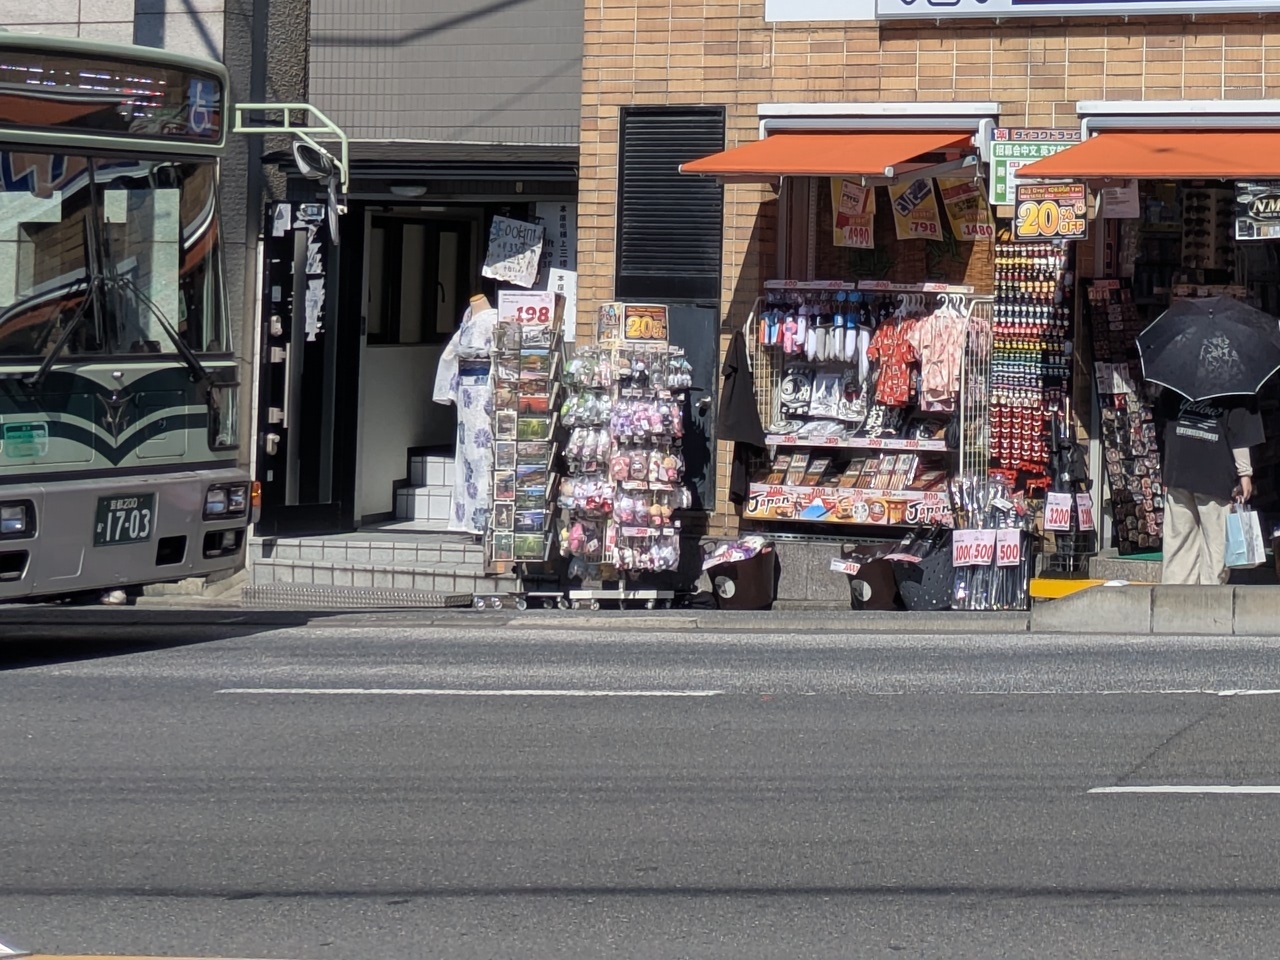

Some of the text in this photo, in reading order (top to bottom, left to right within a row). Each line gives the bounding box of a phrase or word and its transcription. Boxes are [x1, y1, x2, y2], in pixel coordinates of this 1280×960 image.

[911, 221, 937, 234] 798
[965, 224, 993, 236] 1480
[1058, 219, 1086, 235] OFF
[515, 306, 550, 324] 198
[747, 493, 790, 514] Japan
[906, 501, 951, 523] Japan
[106, 509, 151, 541] 17-03
[1050, 508, 1069, 525] 3200
[974, 543, 993, 561] 500
[1000, 544, 1019, 561] 500
